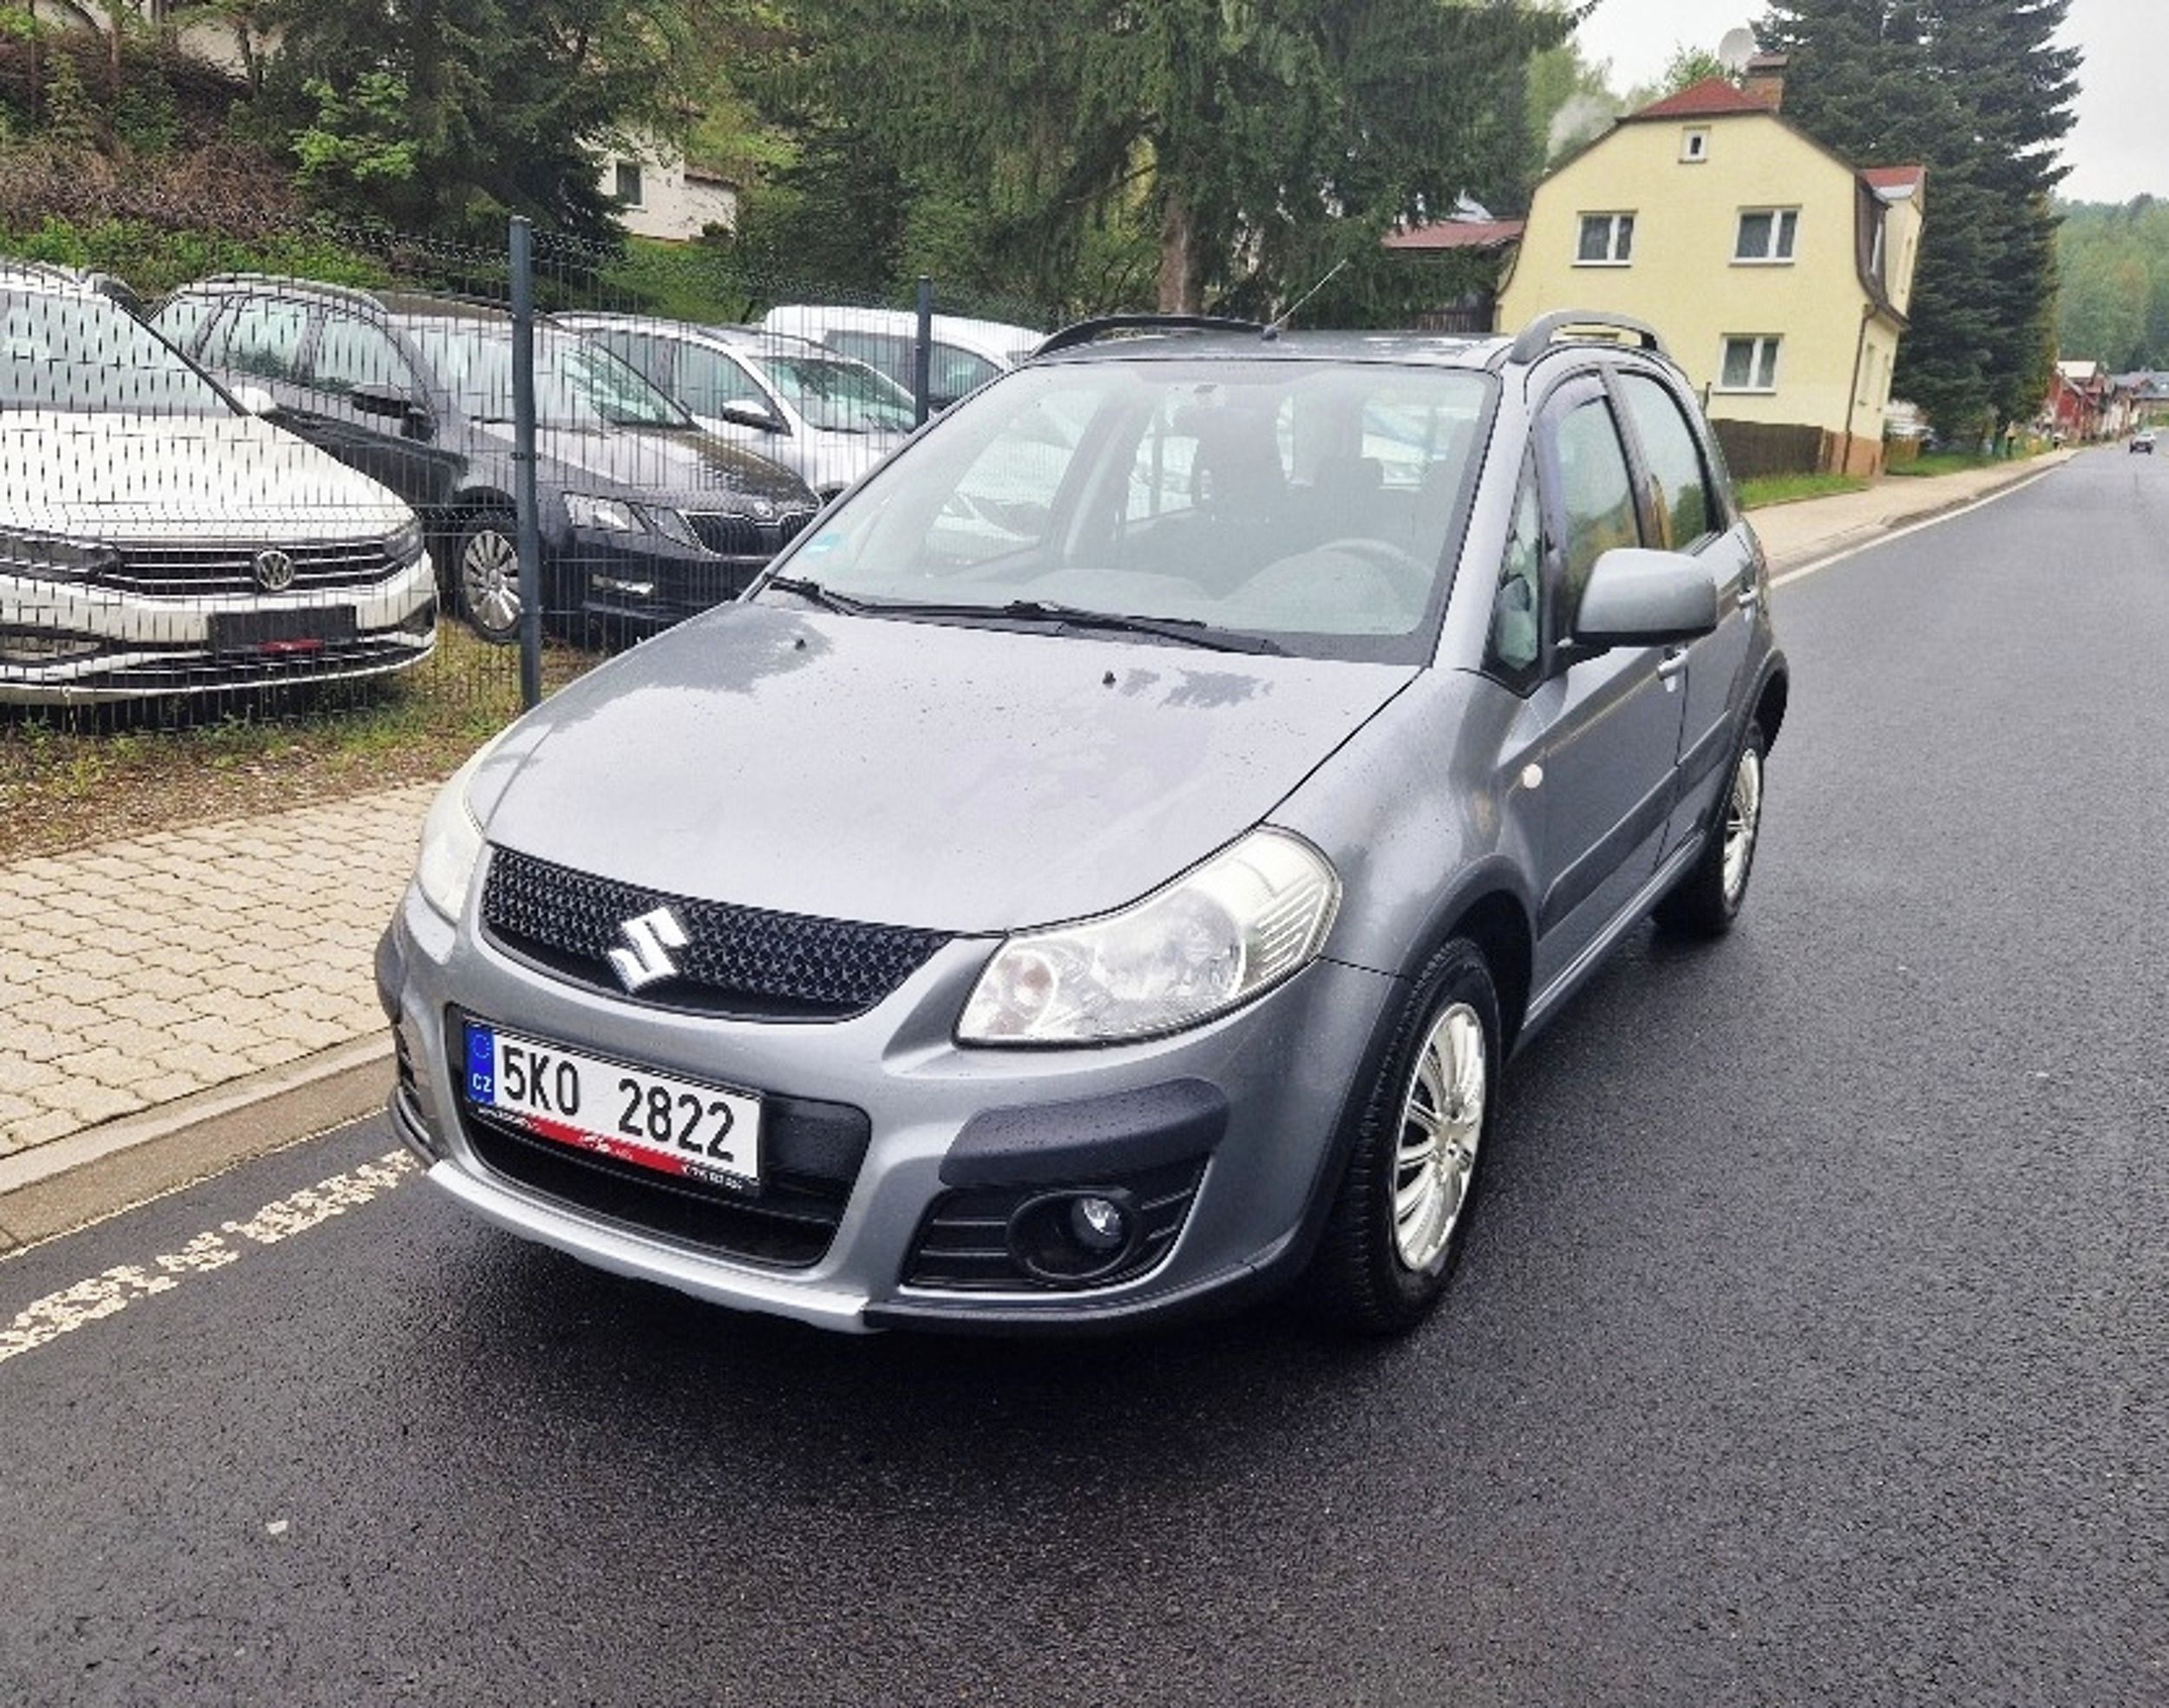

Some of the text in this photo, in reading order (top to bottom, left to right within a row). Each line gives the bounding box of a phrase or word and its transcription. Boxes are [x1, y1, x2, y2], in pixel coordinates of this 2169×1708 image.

[473, 1073, 492, 1093] CZ
[502, 1044, 735, 1162] 5K0 2822
